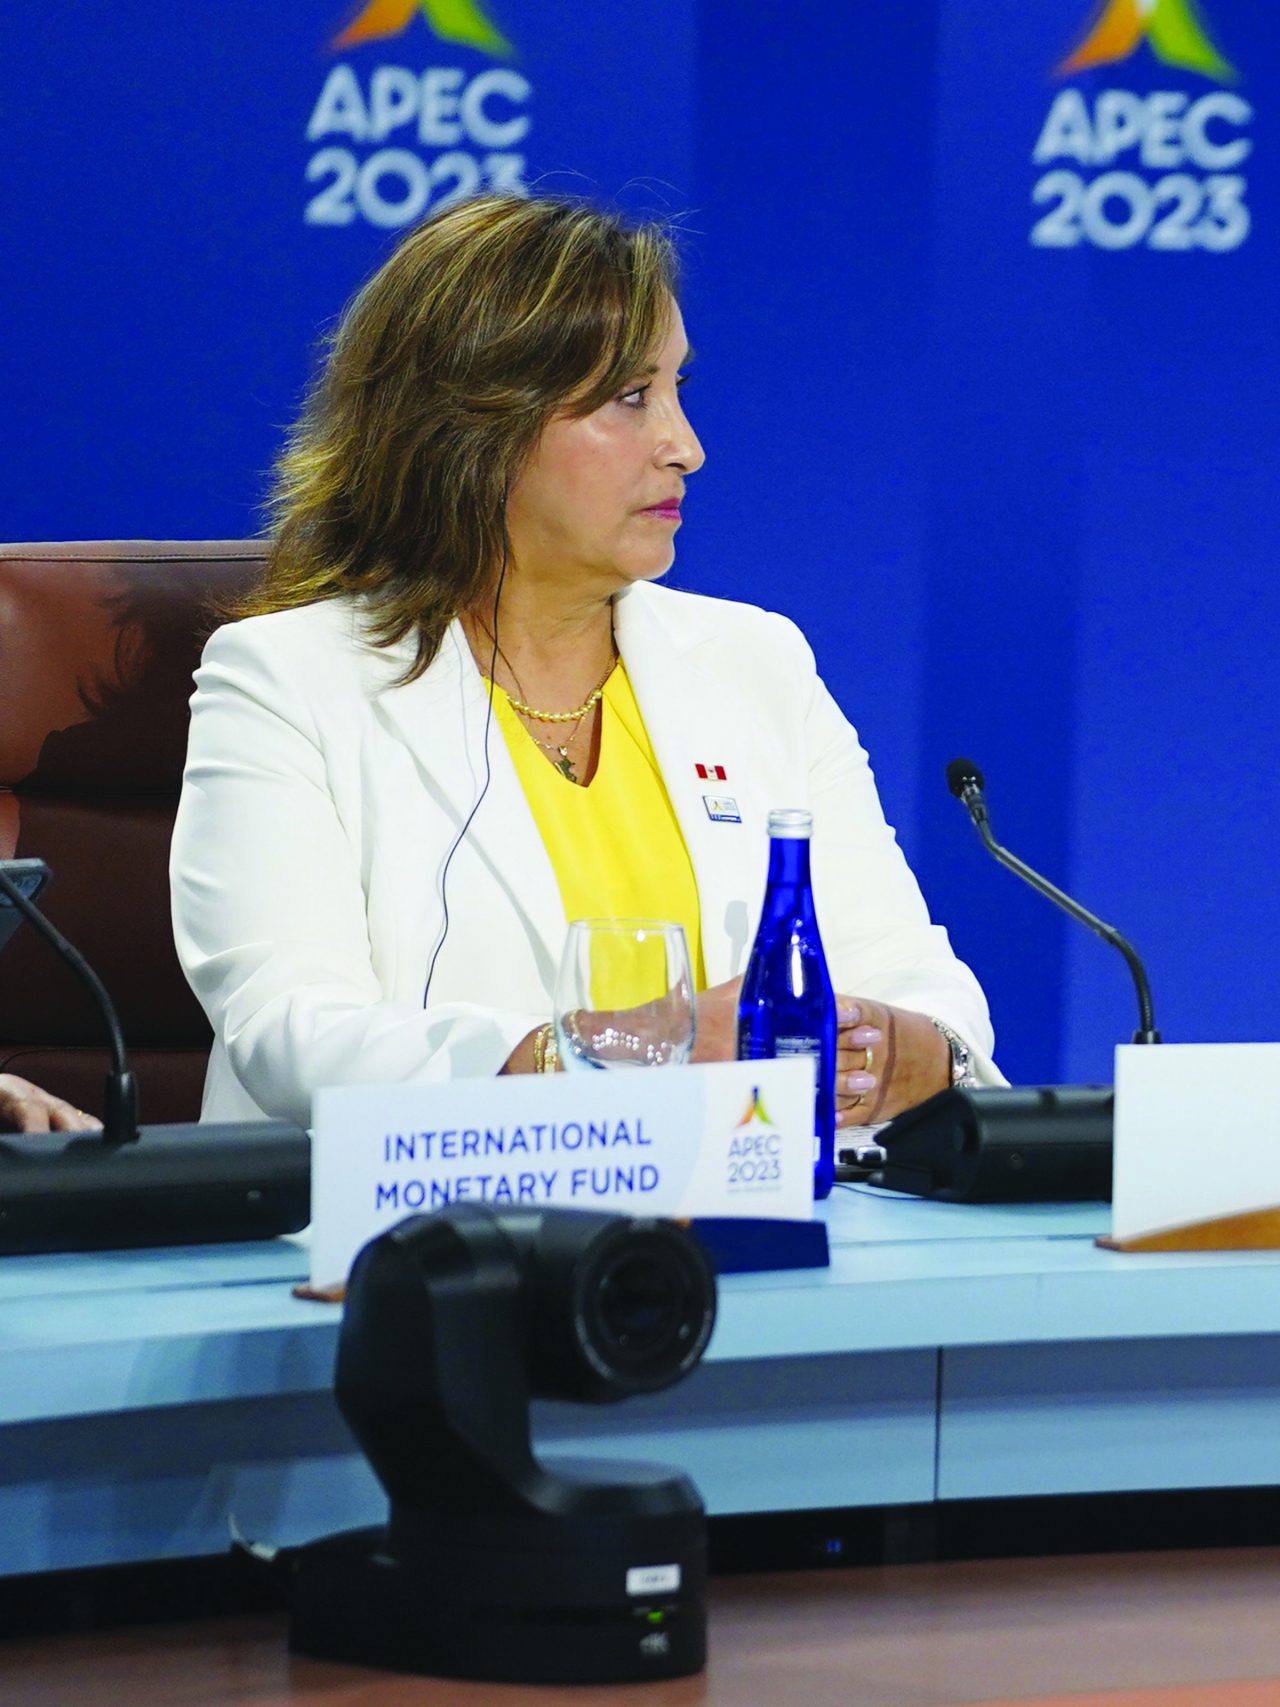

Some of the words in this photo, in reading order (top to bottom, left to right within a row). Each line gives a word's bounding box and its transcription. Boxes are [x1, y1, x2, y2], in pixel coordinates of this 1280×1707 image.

[306, 64, 532, 147] APEC
[1032, 88, 1253, 169] APEC
[1030, 169, 1250, 251] 2023
[385, 1117, 652, 1162] INTERNATIONAL
[728, 1134, 782, 1157] APEC
[375, 1170, 558, 1209] MONETARY
[571, 1164, 659, 1197] FUND
[727, 1158, 781, 1182] 2023
